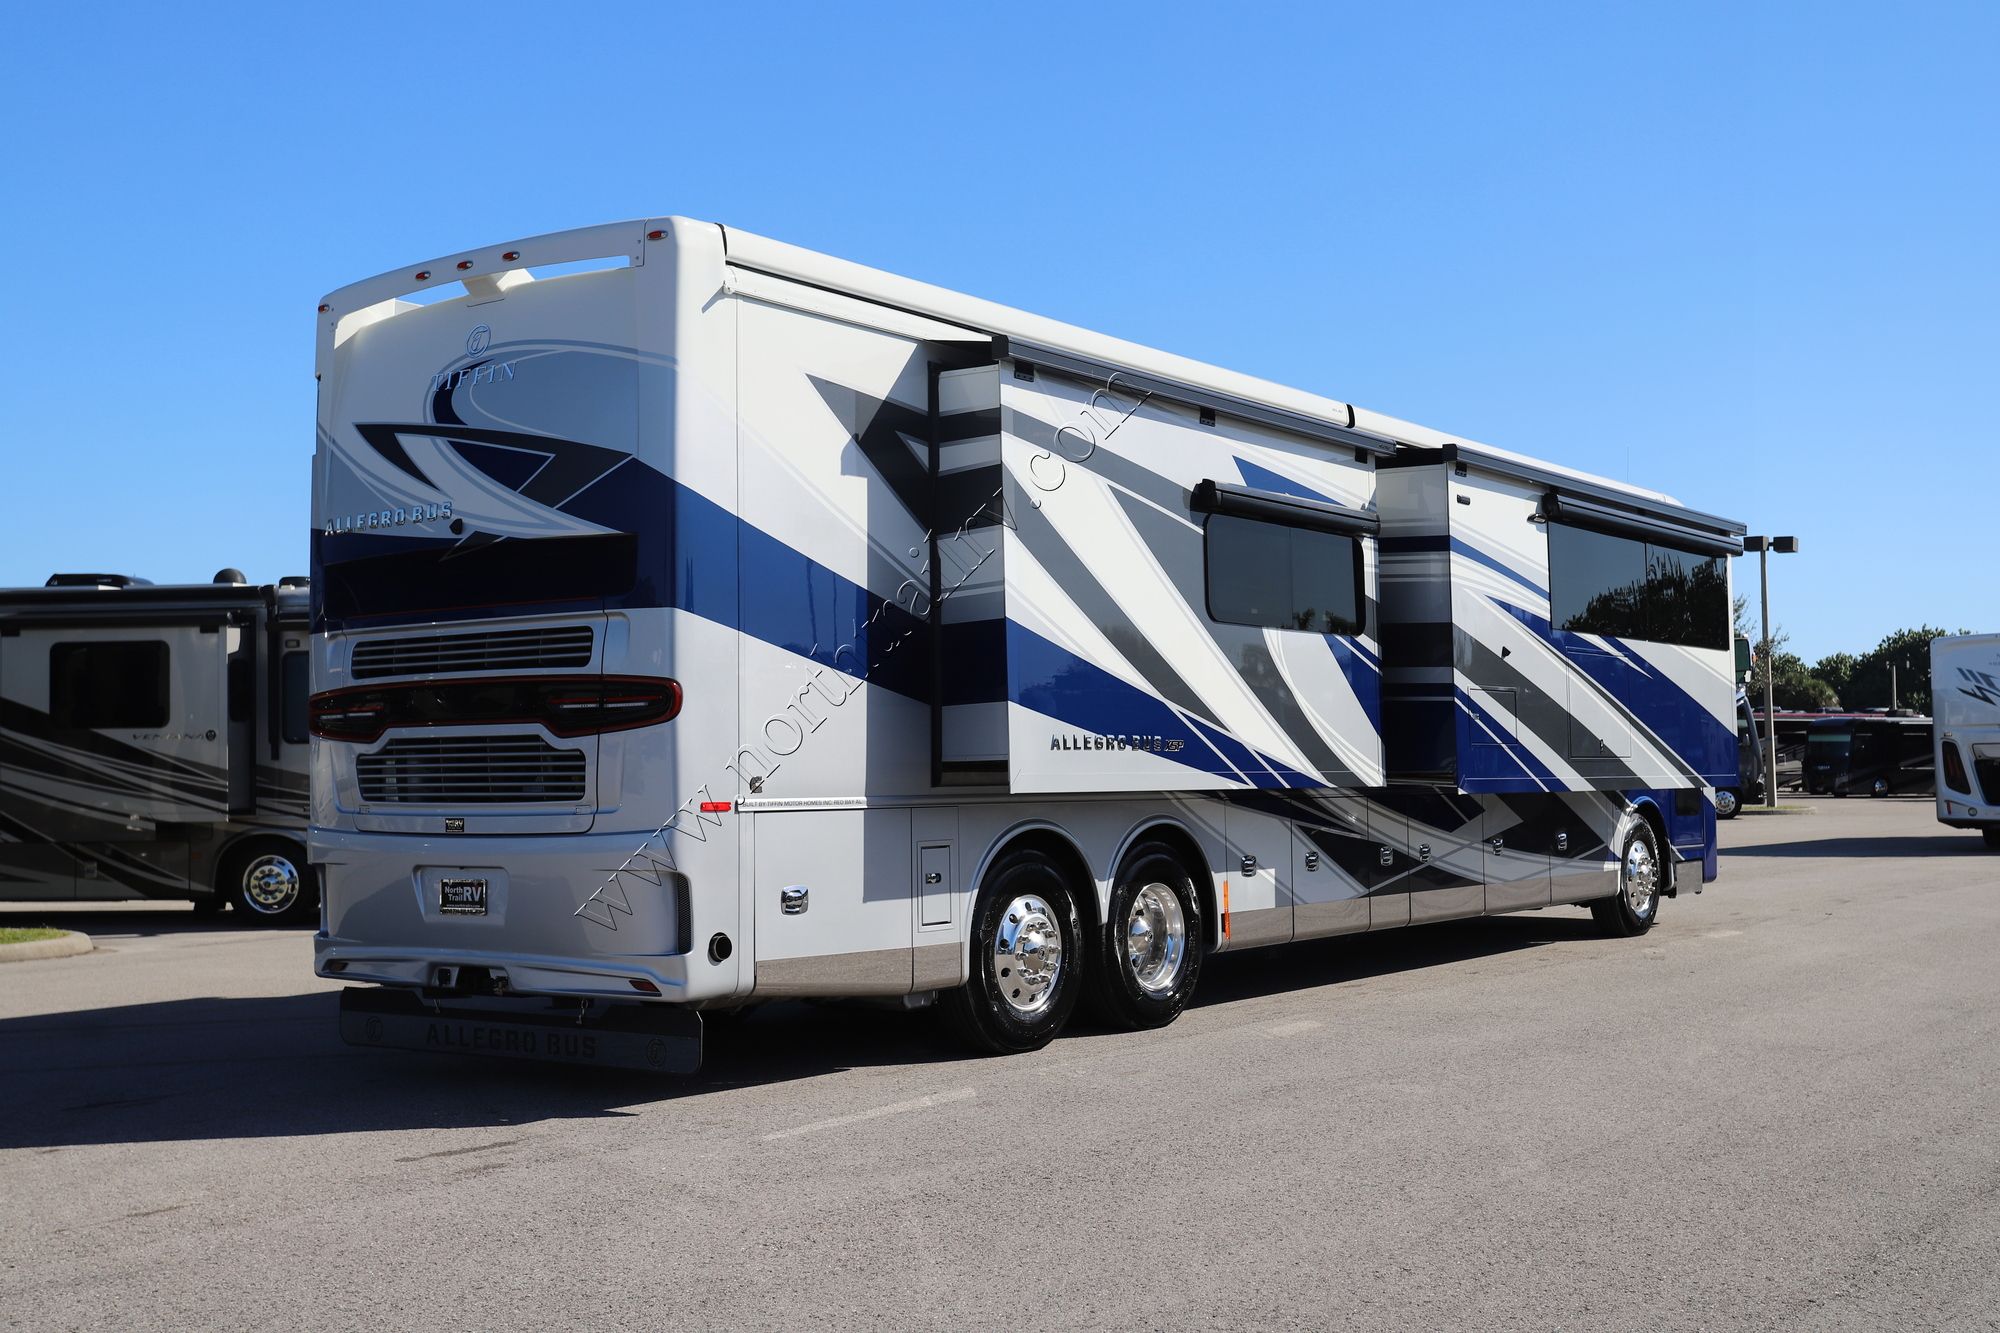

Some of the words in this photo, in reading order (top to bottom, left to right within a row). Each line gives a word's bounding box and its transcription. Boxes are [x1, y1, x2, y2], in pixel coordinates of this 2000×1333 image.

[431, 361, 517, 392] TIFFIN
[324, 508, 406, 536] ALLEGRO
[412, 501, 453, 524] BUS
[1050, 734, 1127, 751] ALLEGRO
[1131, 735, 1162, 751] BUS
[445, 886, 463, 894] North
[463, 886, 482, 902] RV
[426, 1023, 537, 1054] ALLEGRO
[546, 1031, 599, 1058] BUS
